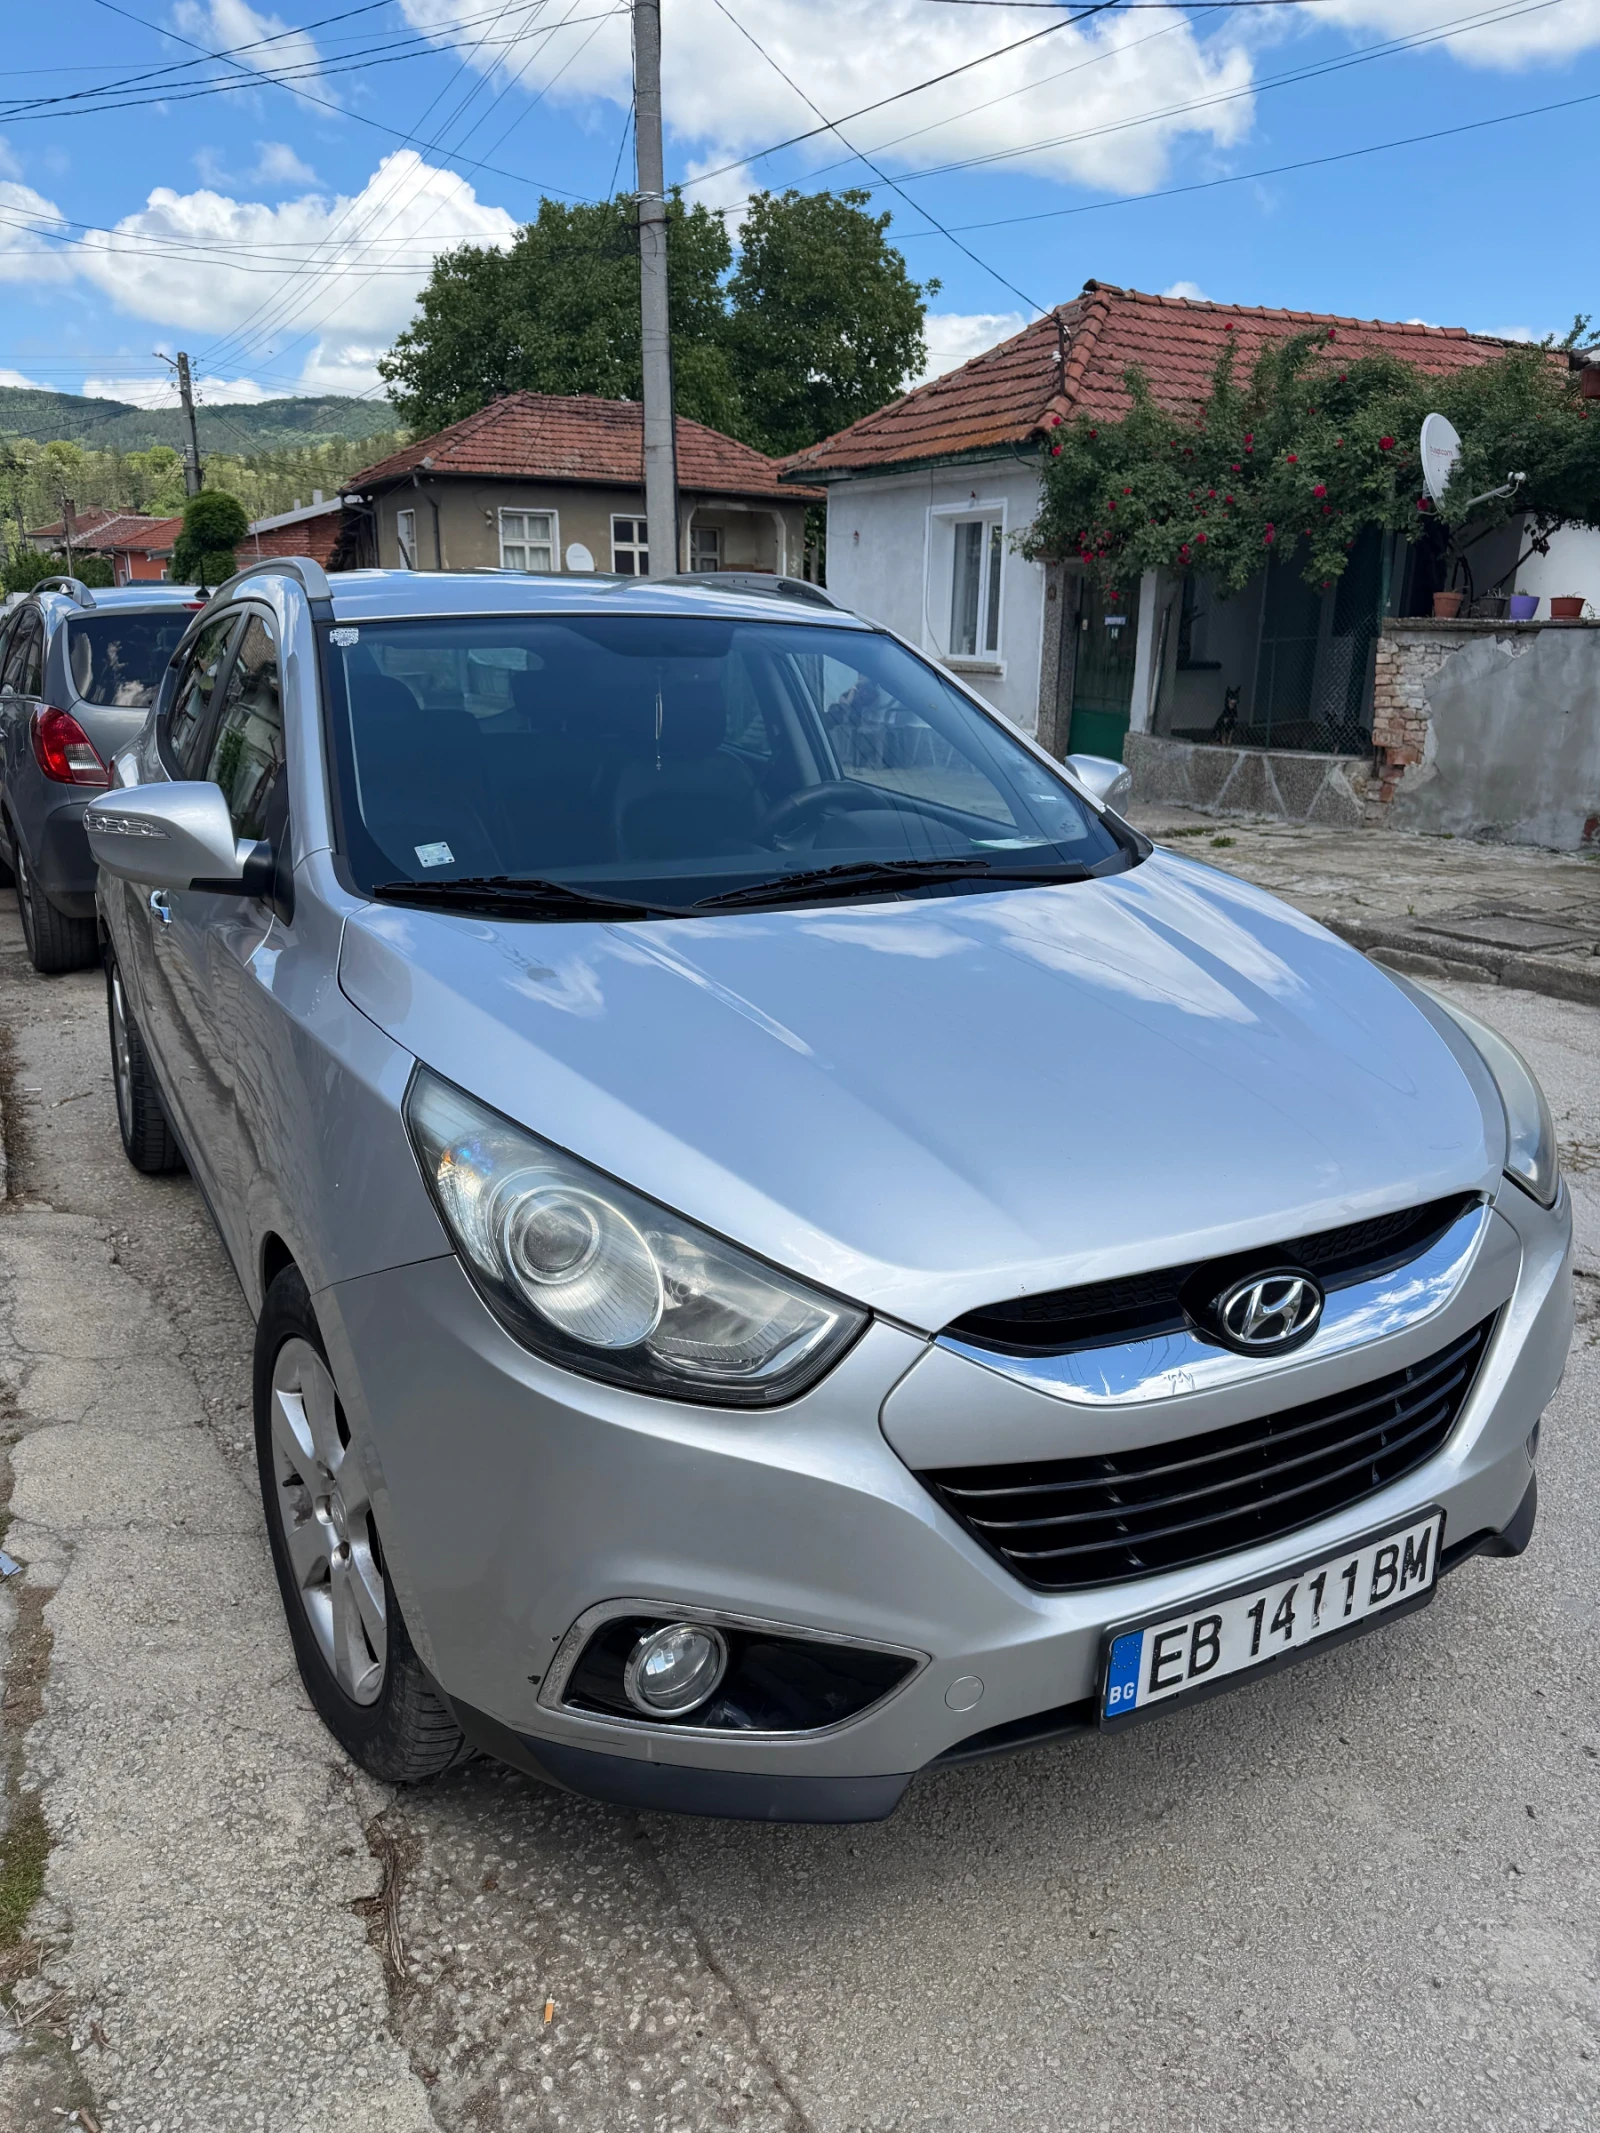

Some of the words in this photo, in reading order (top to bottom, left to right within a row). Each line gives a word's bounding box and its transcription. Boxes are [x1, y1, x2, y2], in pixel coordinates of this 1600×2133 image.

[1149, 1613, 1223, 1693] EB
[1247, 1559, 1360, 1657] 1411
[1369, 1526, 1433, 1606] BM
[1109, 1681, 1135, 1705] BG
